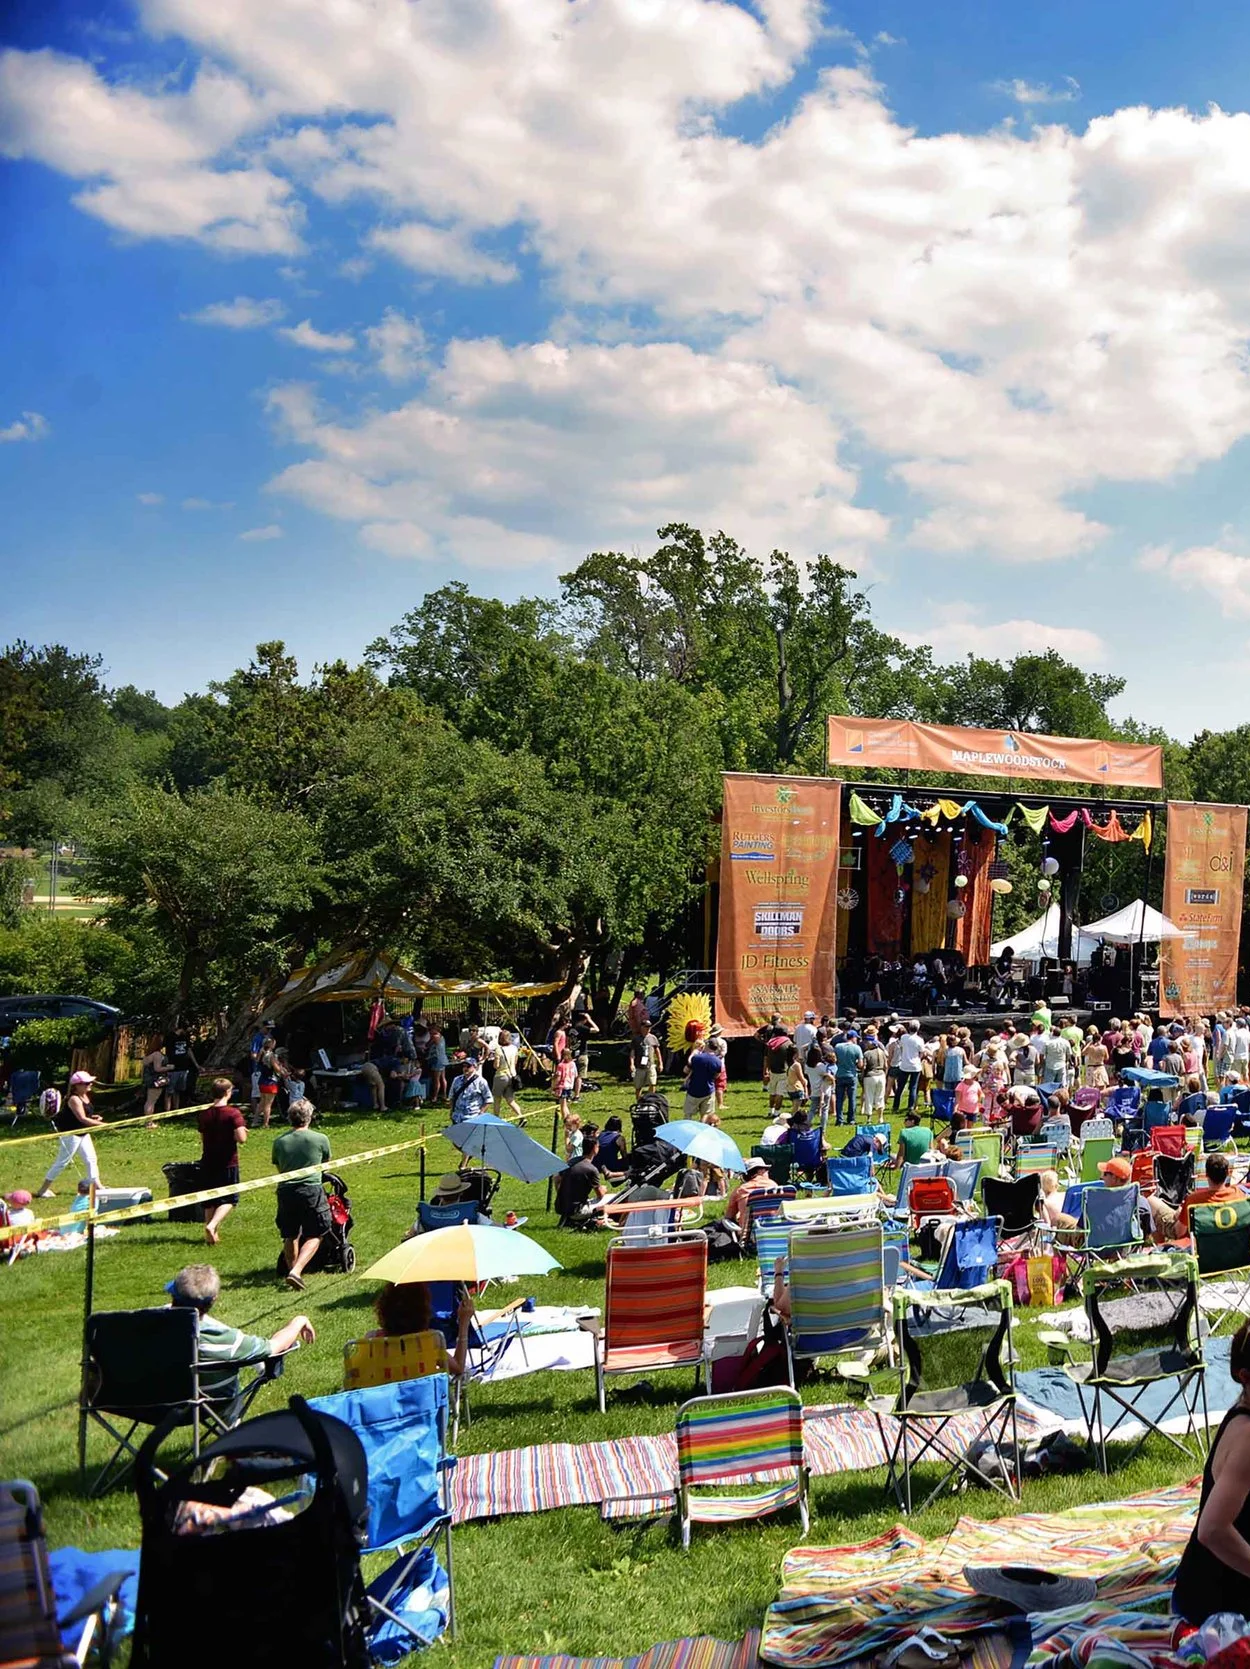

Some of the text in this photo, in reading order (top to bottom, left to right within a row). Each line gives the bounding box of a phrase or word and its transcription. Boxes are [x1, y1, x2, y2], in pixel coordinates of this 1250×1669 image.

[951, 749, 1067, 769] MAPLEWOODSTOCK
[733, 832, 775, 841] RUTGERS
[733, 840, 773, 849] PAINTING
[745, 870, 809, 889] Wellspring
[755, 911, 802, 921] SKILLMAN
[761, 926, 795, 936] DOORS
[741, 954, 809, 970] JD Fitness
[1214, 1206, 1238, 1229] O
